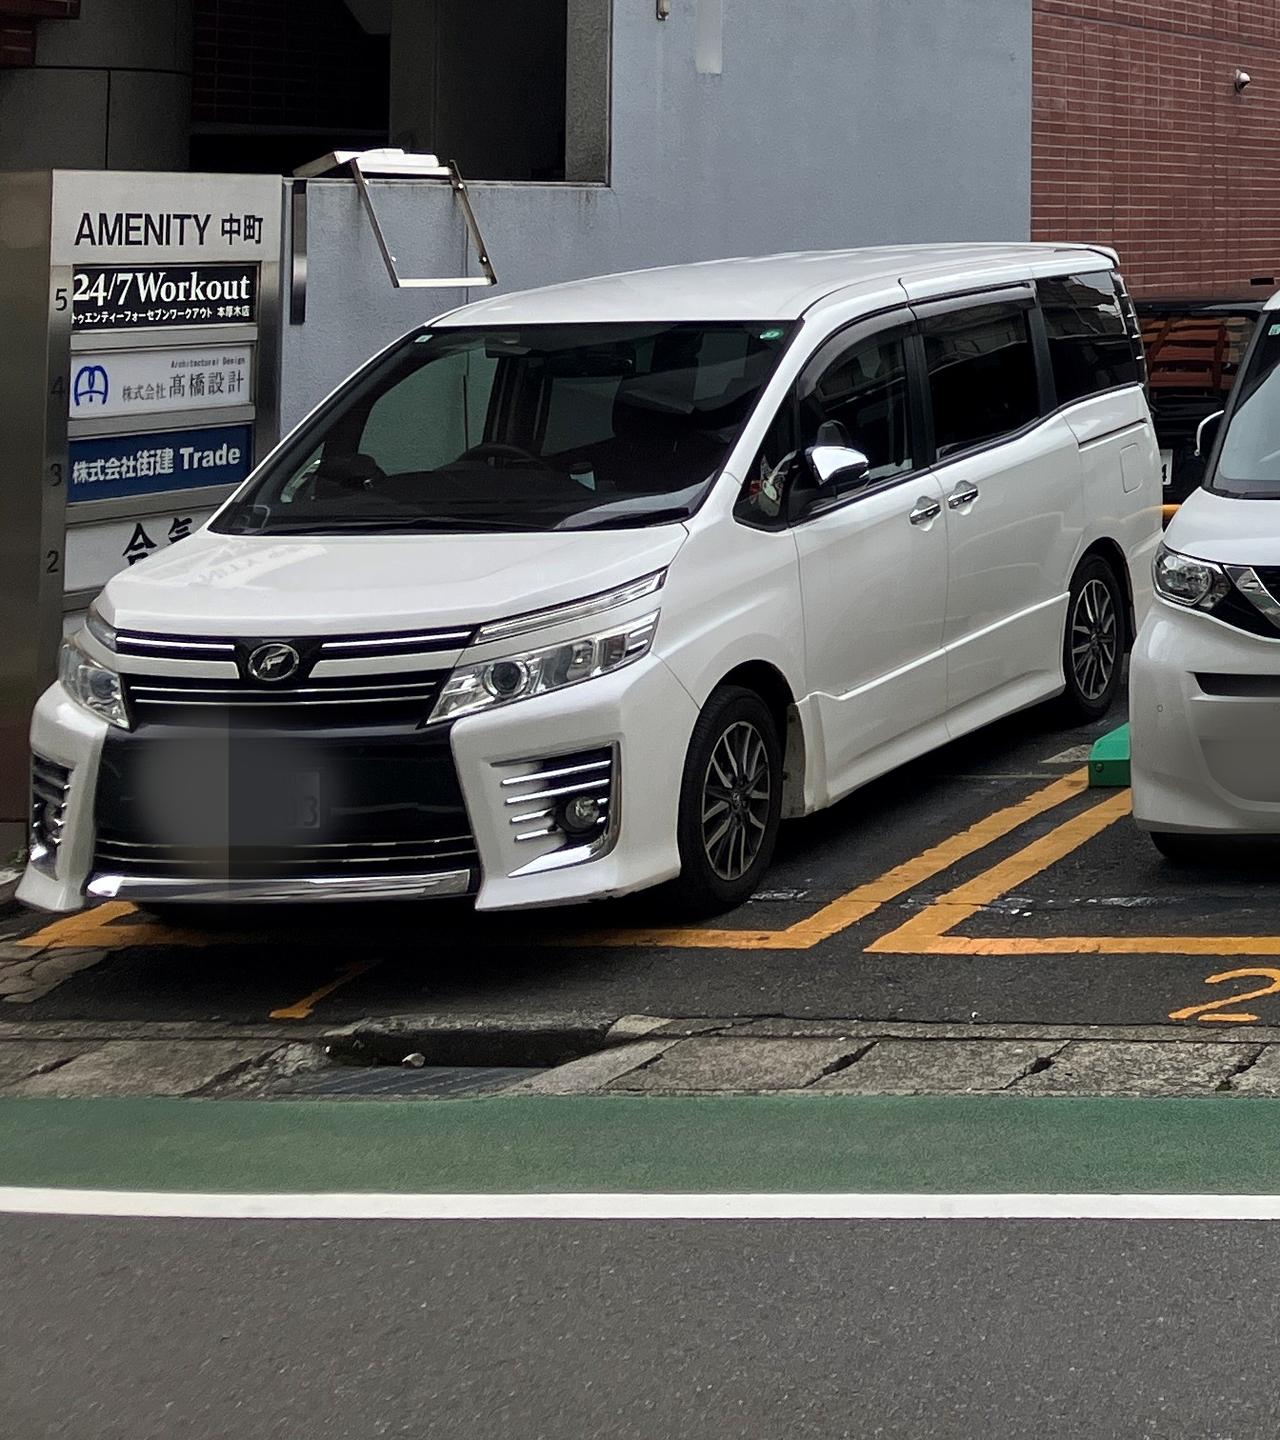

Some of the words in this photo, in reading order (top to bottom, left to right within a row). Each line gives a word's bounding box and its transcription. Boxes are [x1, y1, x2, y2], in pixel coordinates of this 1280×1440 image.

[74, 213, 212, 246] AMENITY
[221, 213, 264, 246] 中町
[55, 288, 68, 311] 5
[217, 305, 250, 318] 本厚木店
[50, 463, 62, 486] 3
[72, 447, 174, 485] 株式会社街建
[179, 442, 241, 470] Trade
[46, 550, 60, 573] 2
